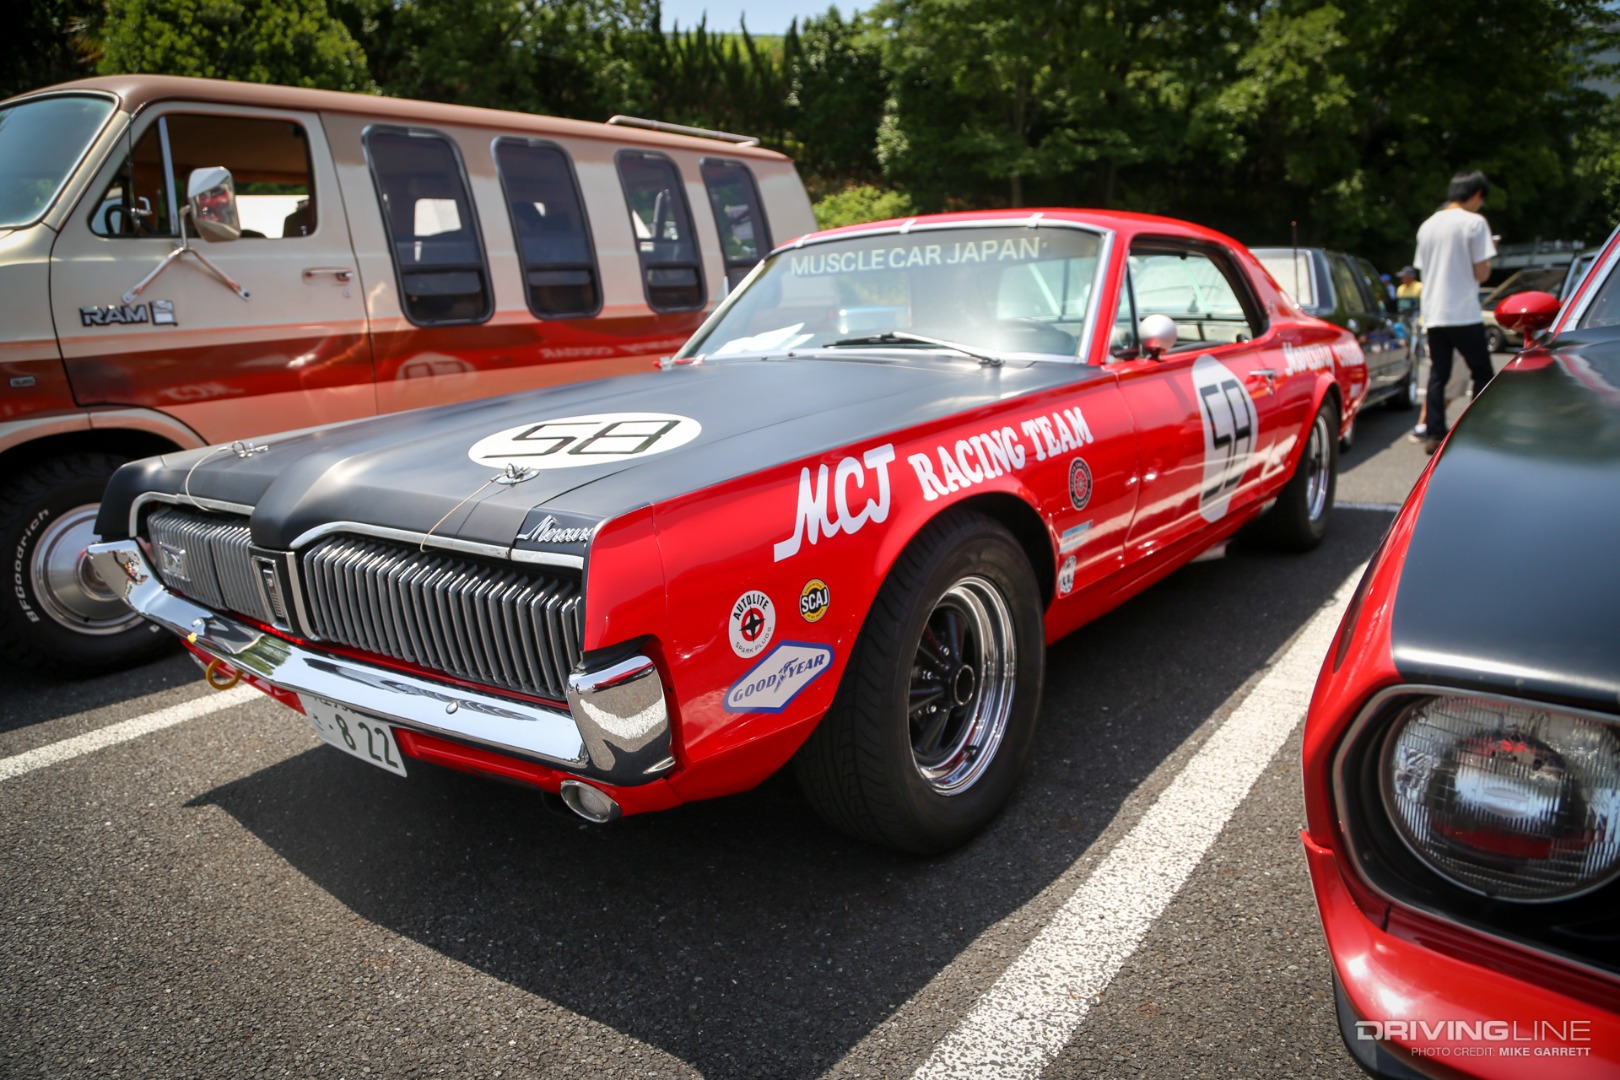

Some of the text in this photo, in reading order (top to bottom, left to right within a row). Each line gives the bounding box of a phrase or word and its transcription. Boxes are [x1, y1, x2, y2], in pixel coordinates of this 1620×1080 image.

[790, 236, 1041, 276] MUSCLE CAR JAPAN
[79, 303, 149, 327] RAM
[480, 419, 682, 460] 58
[907, 426, 1026, 502] RACING
[1020, 406, 1094, 462] TEAM
[773, 442, 896, 563] MCJ
[14, 508, 50, 623] BFGoodrich
[733, 593, 770, 622] AUTOLITE
[801, 588, 829, 613] SCAJ
[735, 626, 772, 654] SPARK PLUGS
